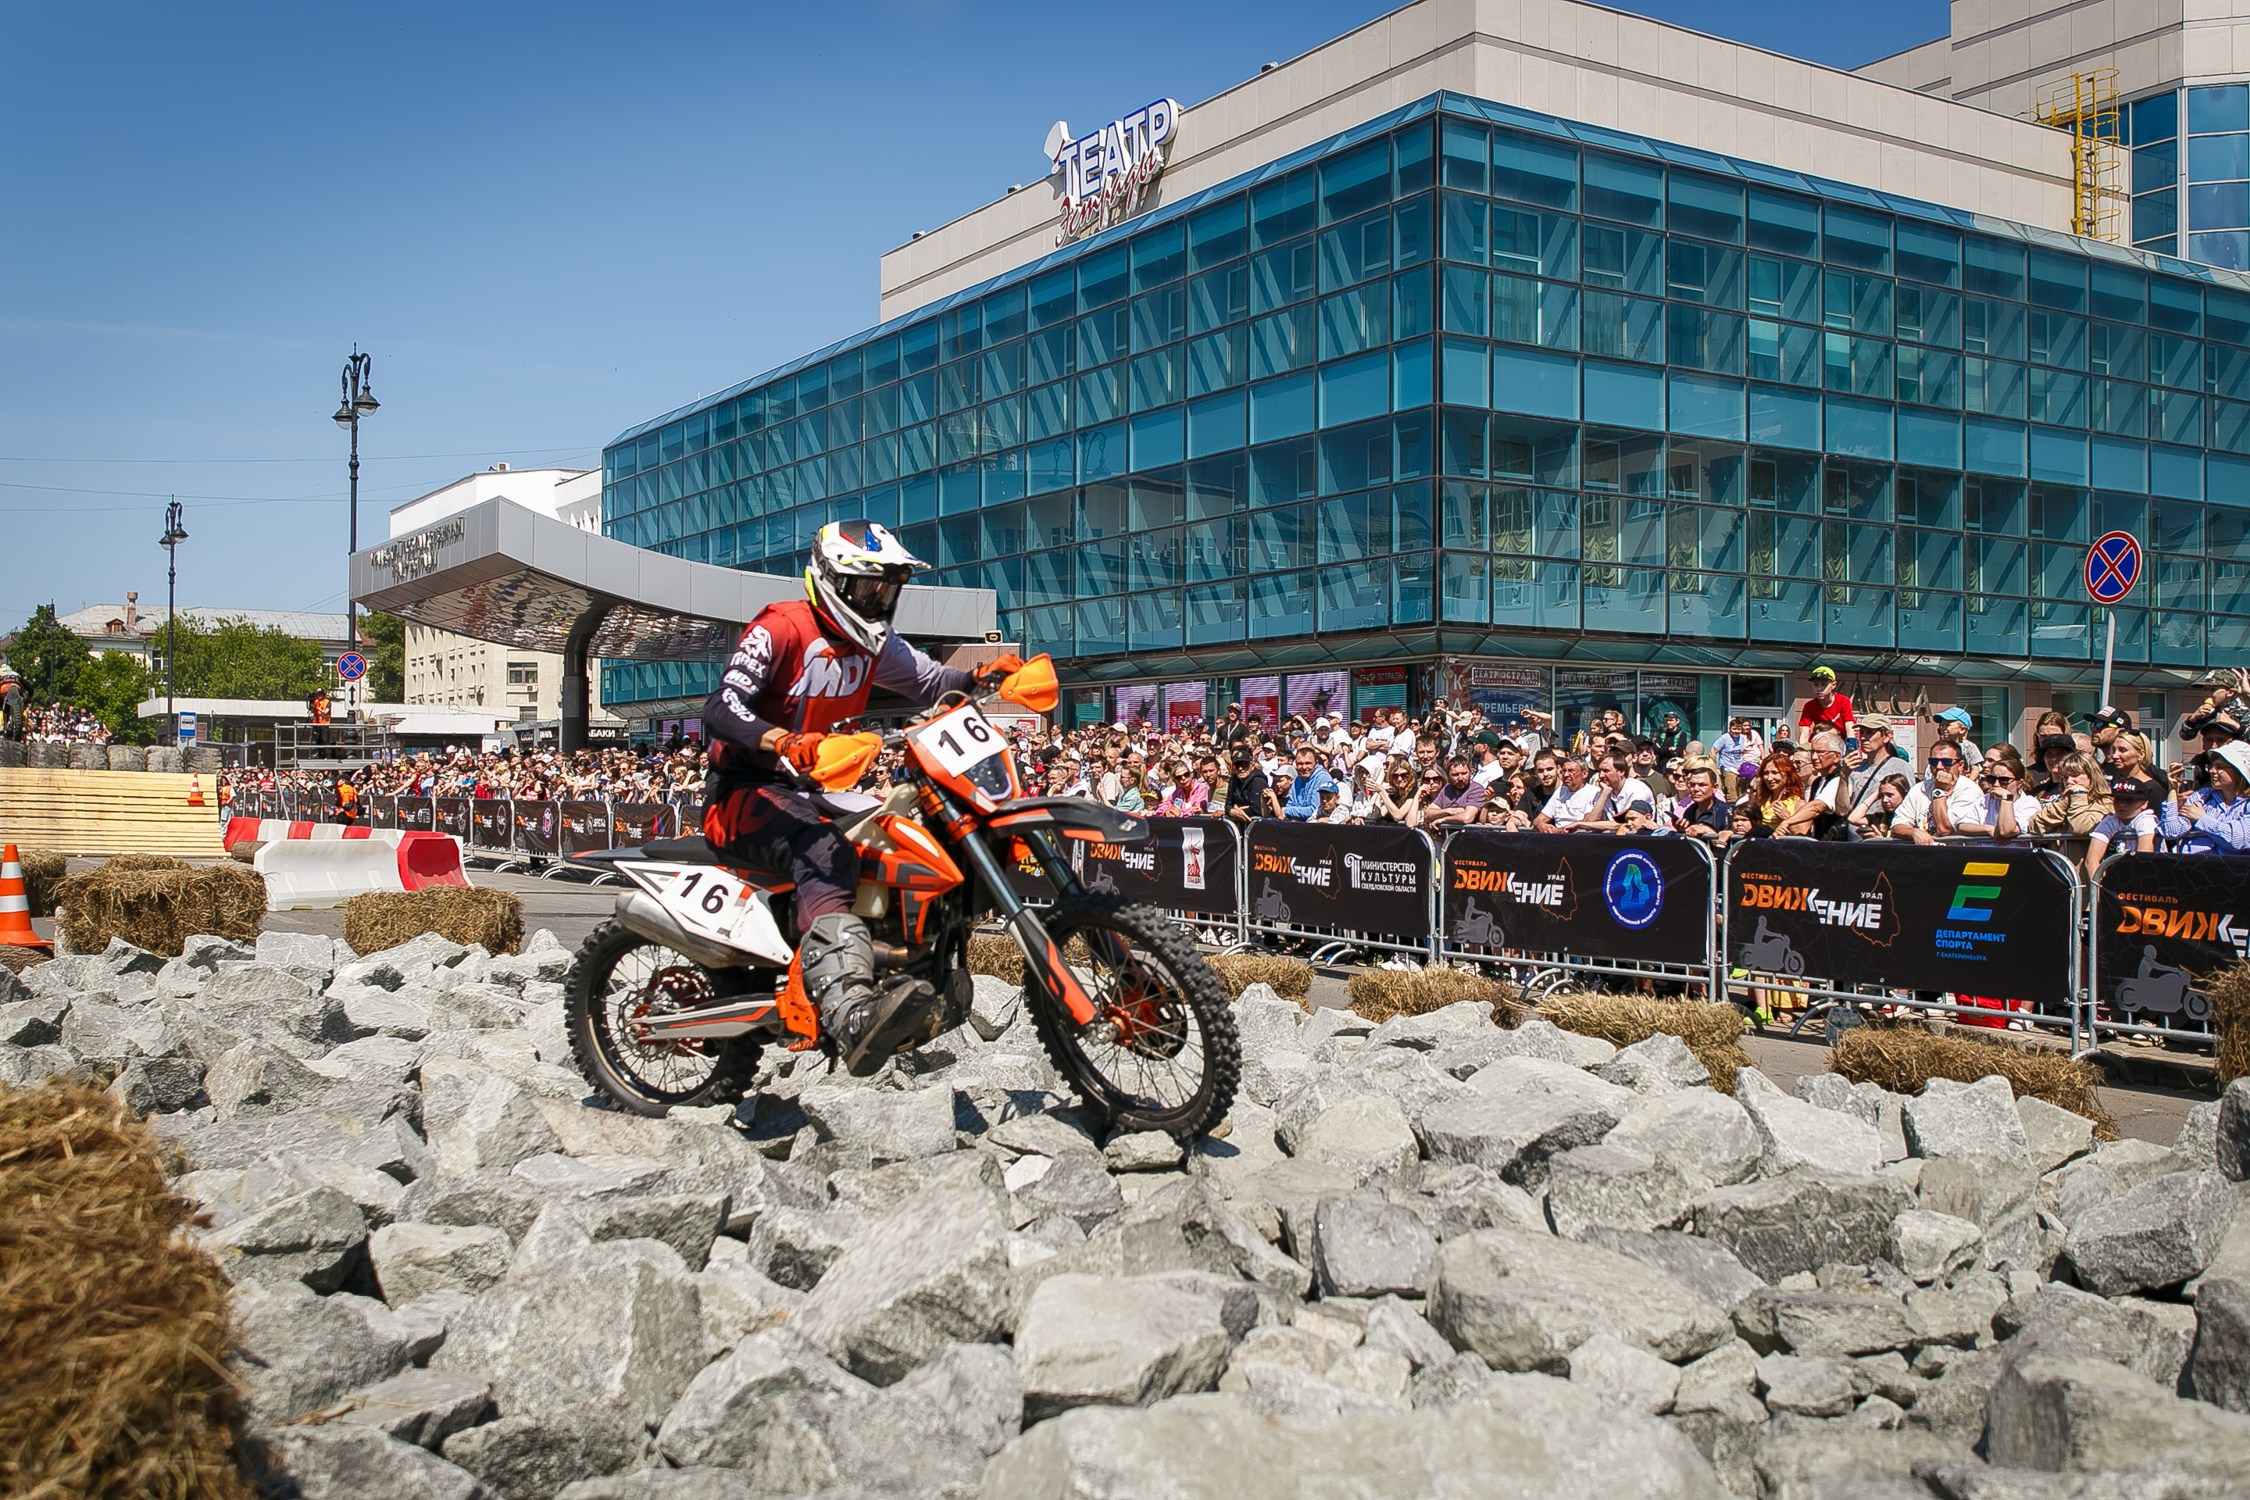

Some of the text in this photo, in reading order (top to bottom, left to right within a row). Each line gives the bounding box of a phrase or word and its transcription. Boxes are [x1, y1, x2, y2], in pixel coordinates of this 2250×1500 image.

[1058, 97, 1179, 199] ТЕАТР
[1640, 677, 1659, 686] ЕАТР
[1837, 681, 1931, 723] АССА
[938, 717, 990, 757] 16
[1361, 860, 1416, 873] МИНИСТЕРСТВО
[1454, 859, 1488, 867] ФЕСТИВАЛЬ
[1254, 853, 1331, 887] ДВИЖЕНИЕ
[1361, 872, 1416, 885] КУЛЬТУРЫ
[1740, 872, 1783, 882] ФЕСТИВАЛЬ
[680, 872, 729, 914] 16
[1361, 883, 1417, 893] СВЕРДЛОВСКОЙ ОБЛАСТИ
[1453, 869, 1564, 906] ДВИЖЕНИЕ
[1860, 891, 1883, 900] УРАЛ
[2117, 893, 2179, 904] ФЕСТИВАЛЬ
[1740, 883, 1882, 929] ДВИЖЕНИЕ
[1935, 929, 2006, 943] ДЕПАРТАМЕНТ
[2116, 905, 2250, 958] ДВИЖЕ
[1935, 939, 1973, 950] СПОРТА
